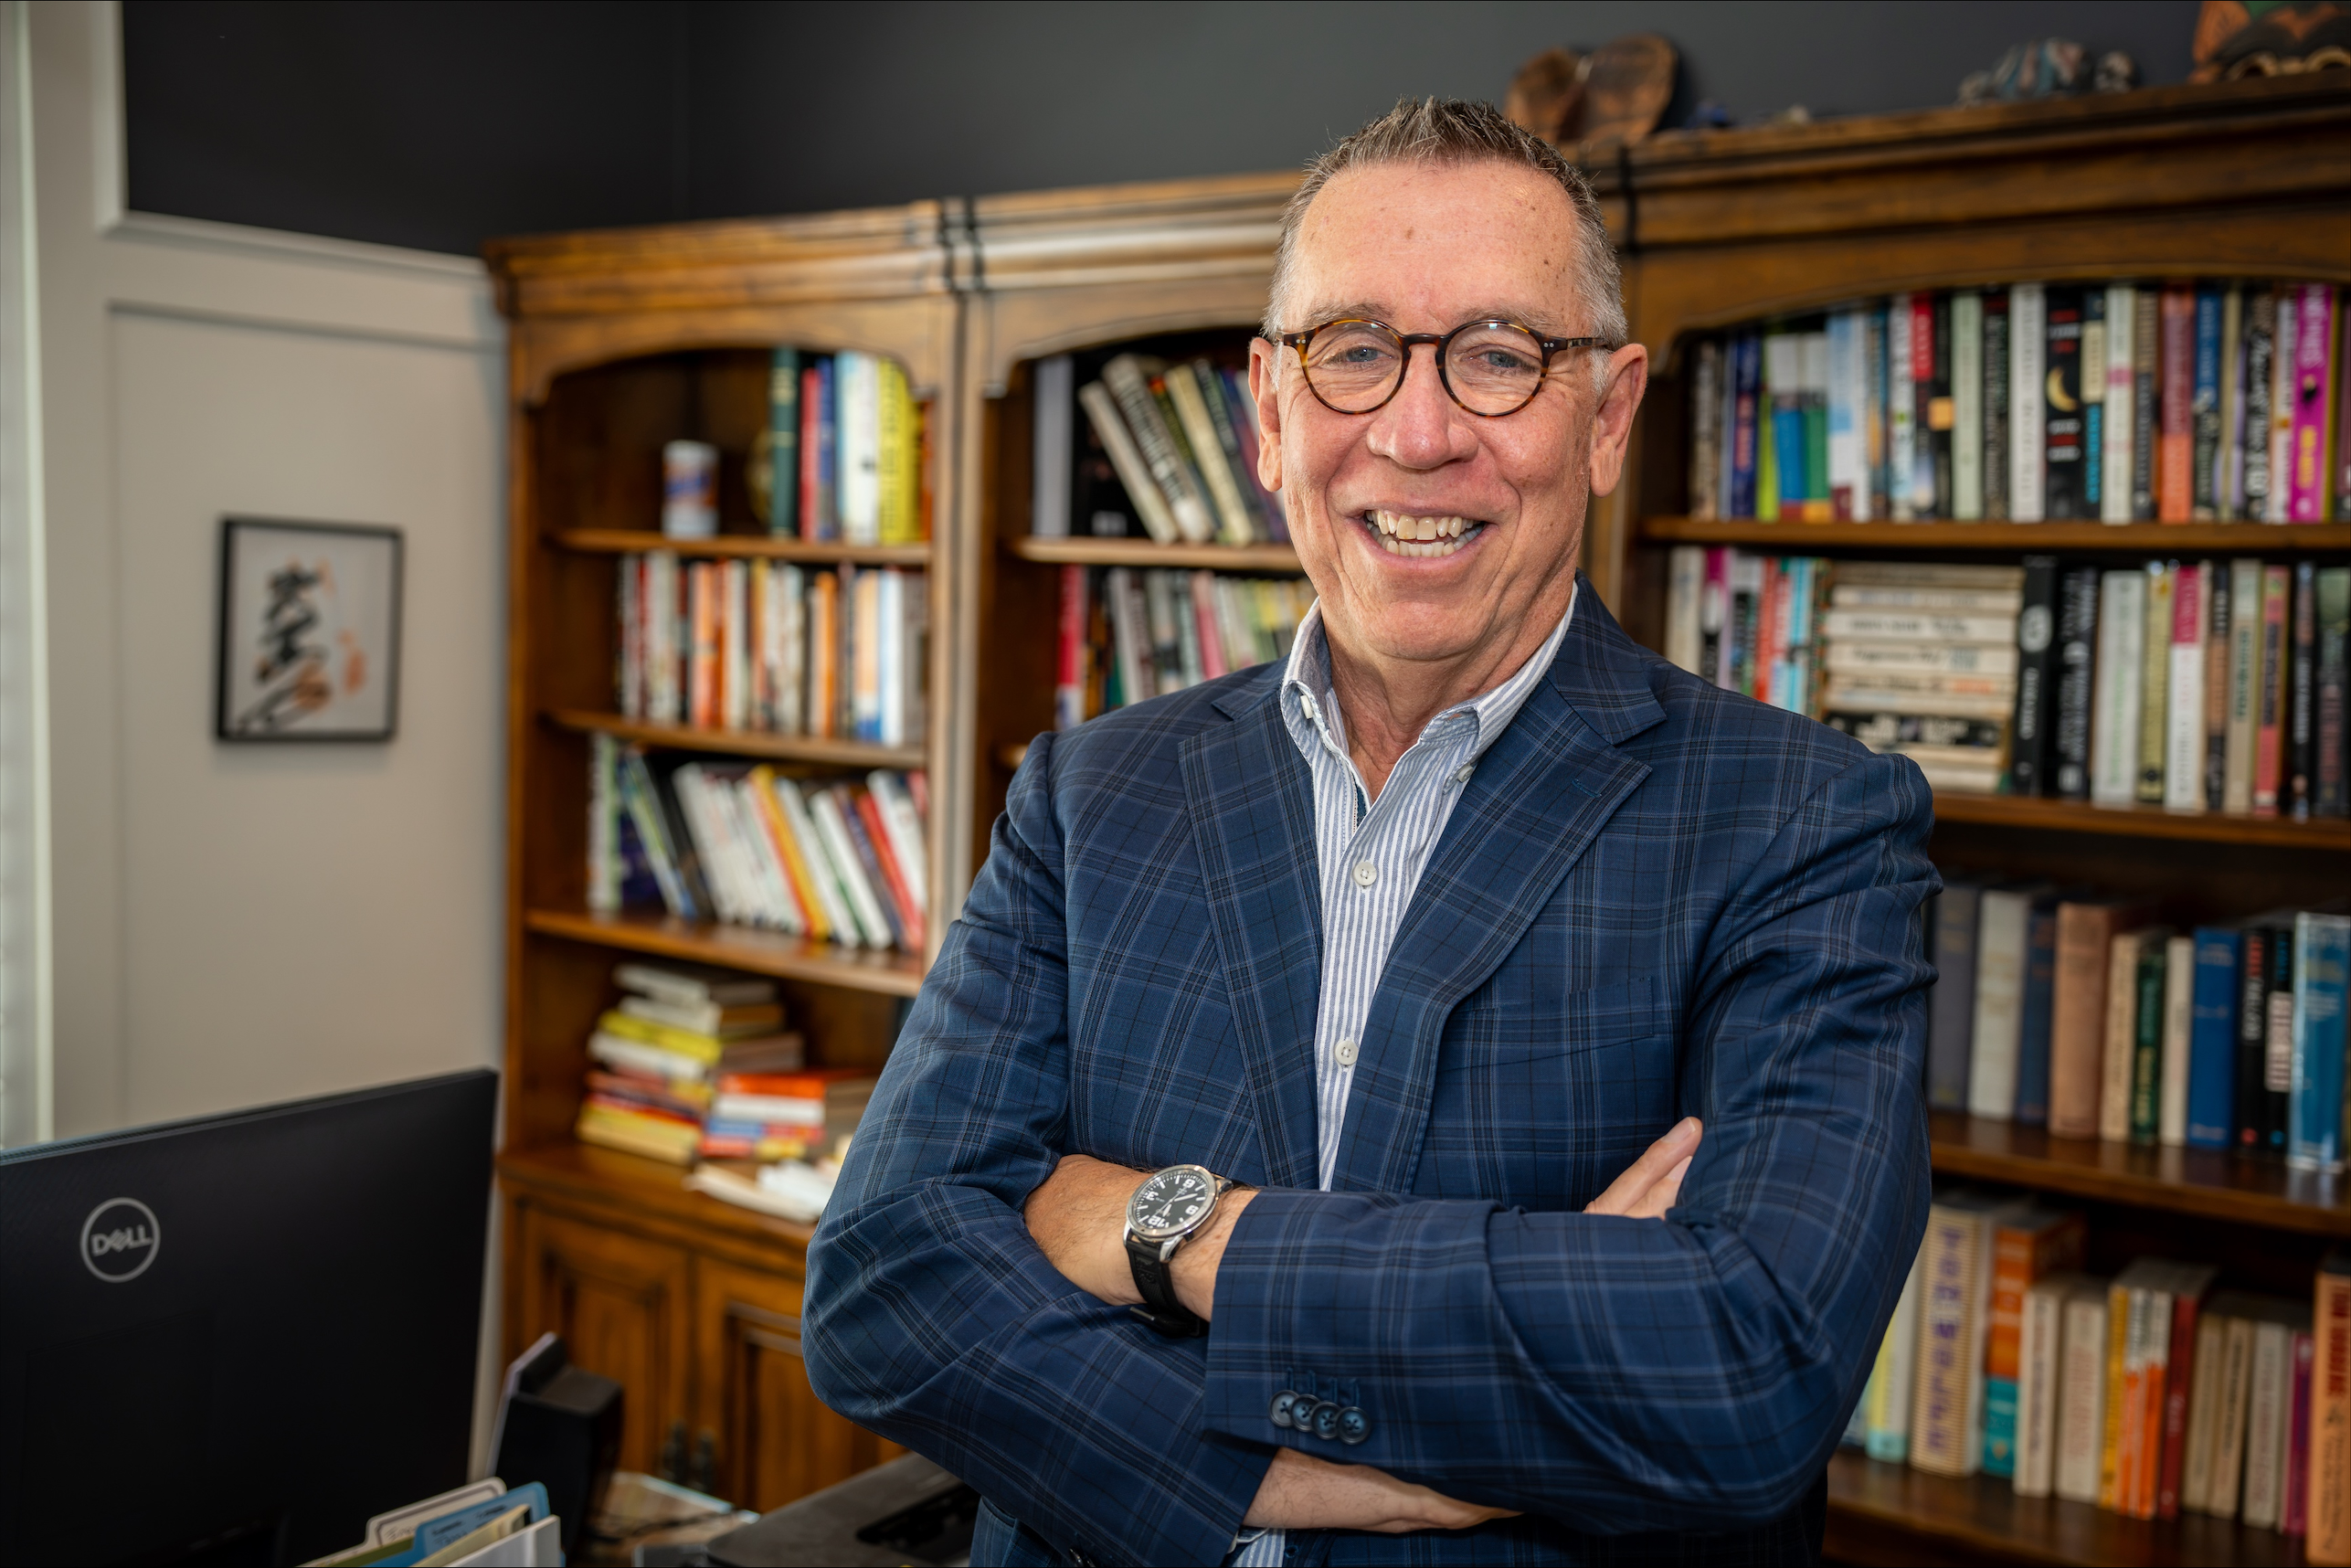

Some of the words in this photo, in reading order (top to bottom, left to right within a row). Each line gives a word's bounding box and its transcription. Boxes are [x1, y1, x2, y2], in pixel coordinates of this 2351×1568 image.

[1182, 1178, 1196, 1188] 6
[1146, 1191, 1159, 1202] 3
[1185, 1204, 1199, 1215] 9
[1148, 1214, 1165, 1227] 12
[90, 1224, 154, 1257] DELL
